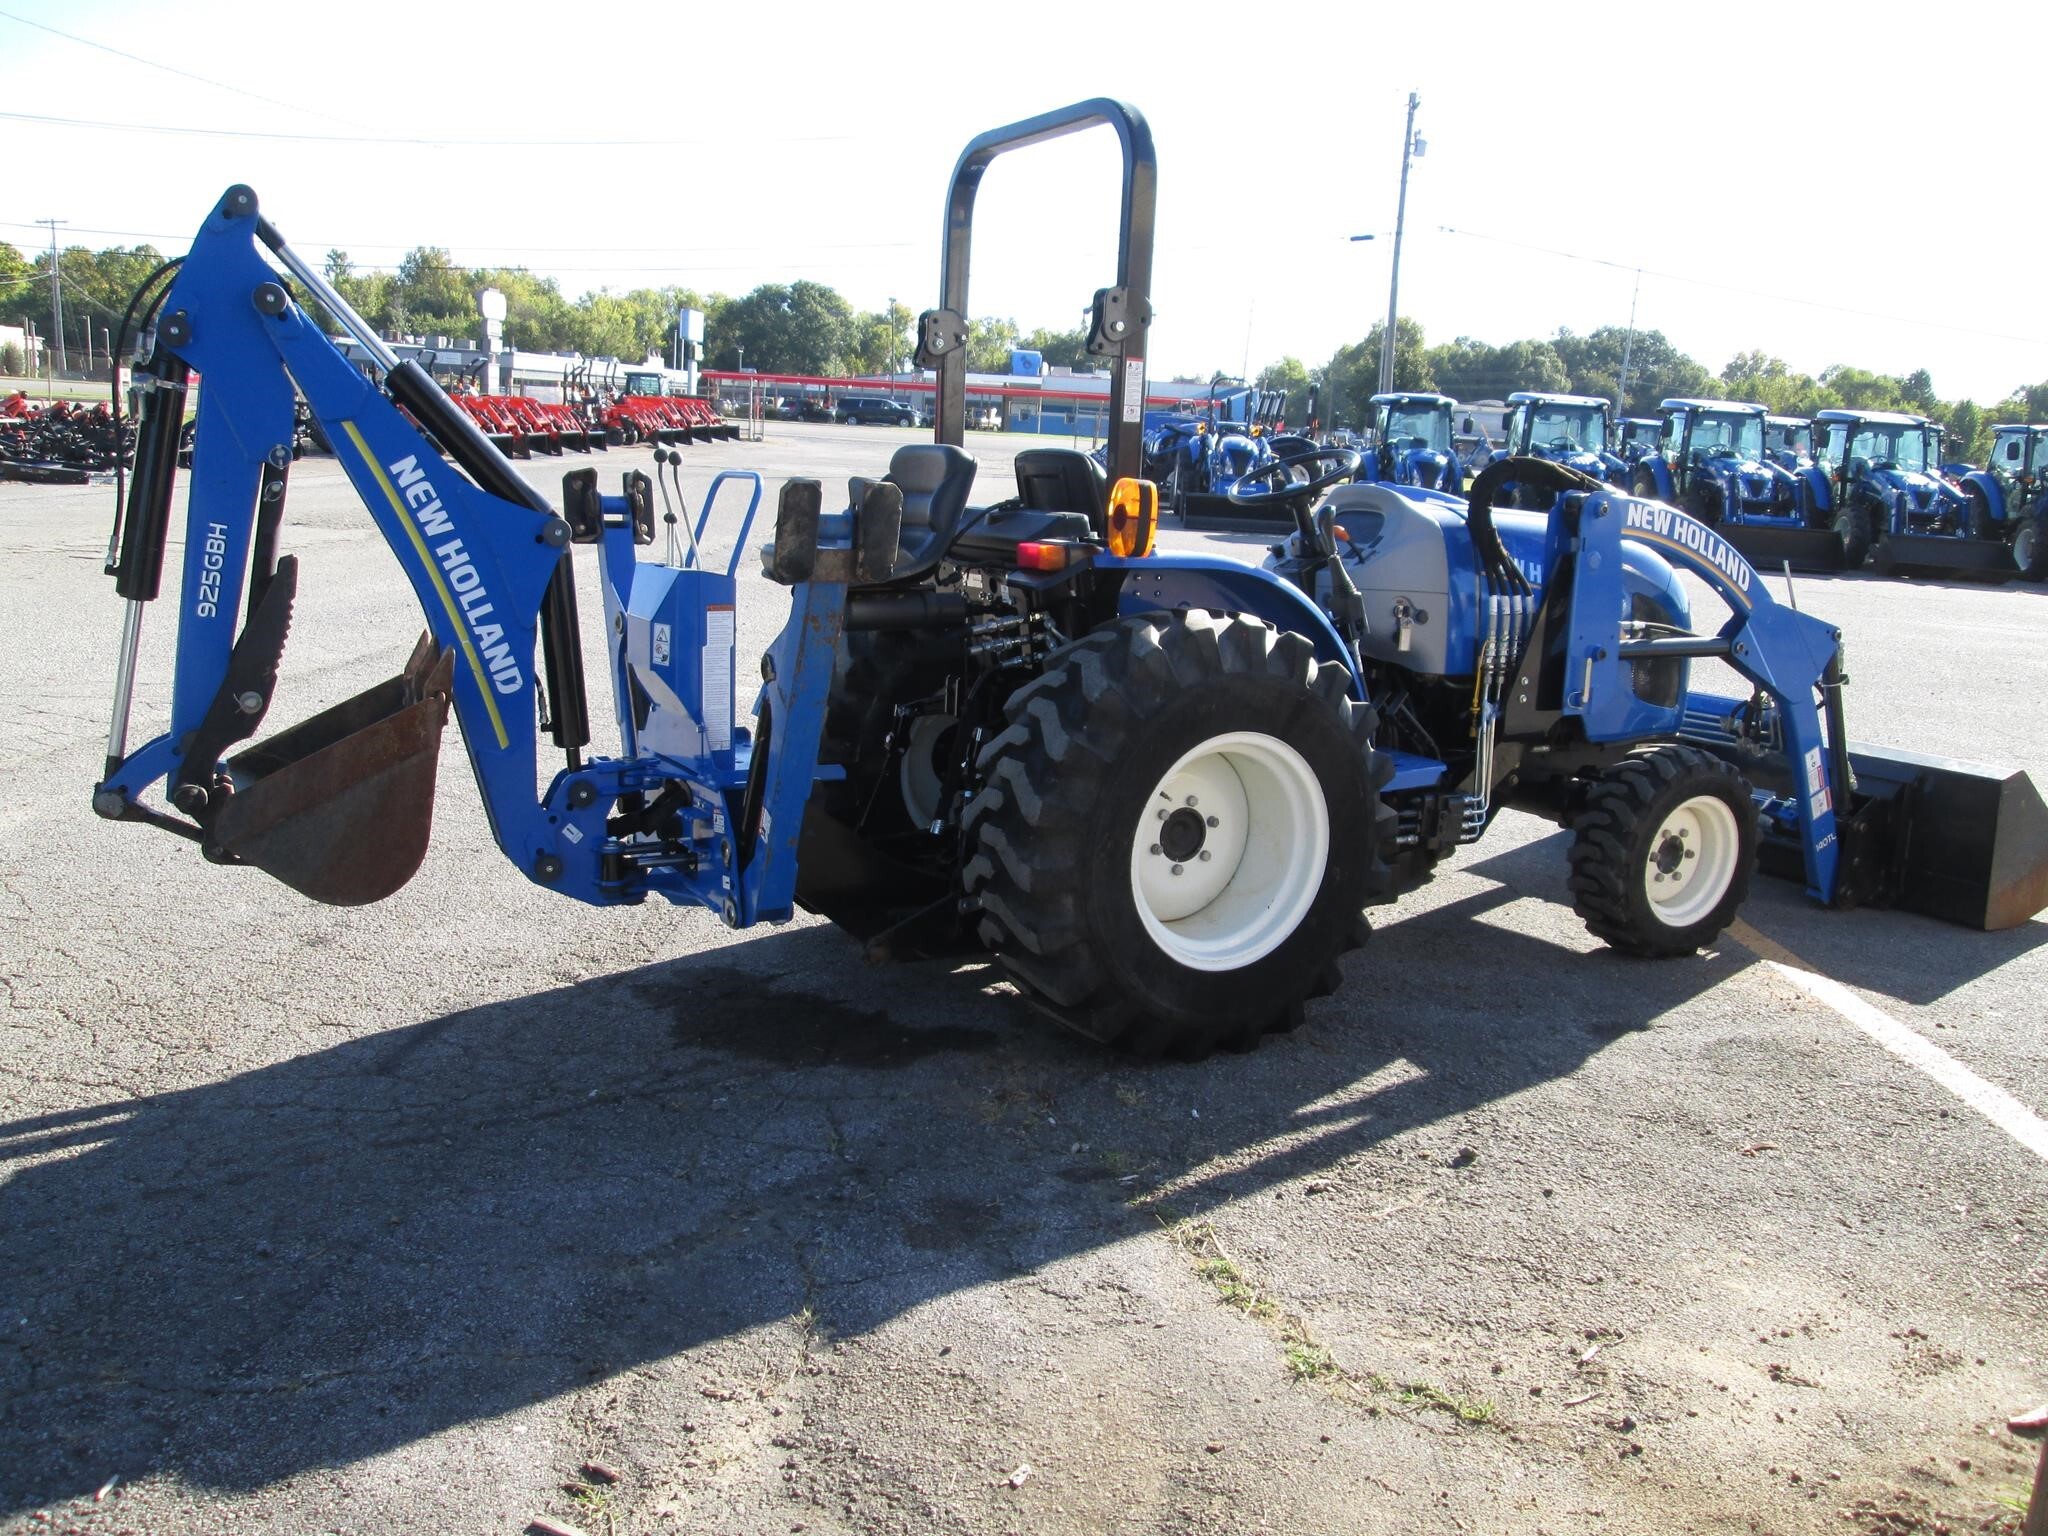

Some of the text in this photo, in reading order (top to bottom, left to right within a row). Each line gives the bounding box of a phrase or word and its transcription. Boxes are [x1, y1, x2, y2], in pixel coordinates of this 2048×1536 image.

[197, 522, 228, 618] 925GBH
[389, 454, 523, 695] NEW HOLLAND
[1627, 502, 1750, 592] NEW HOLLAND
